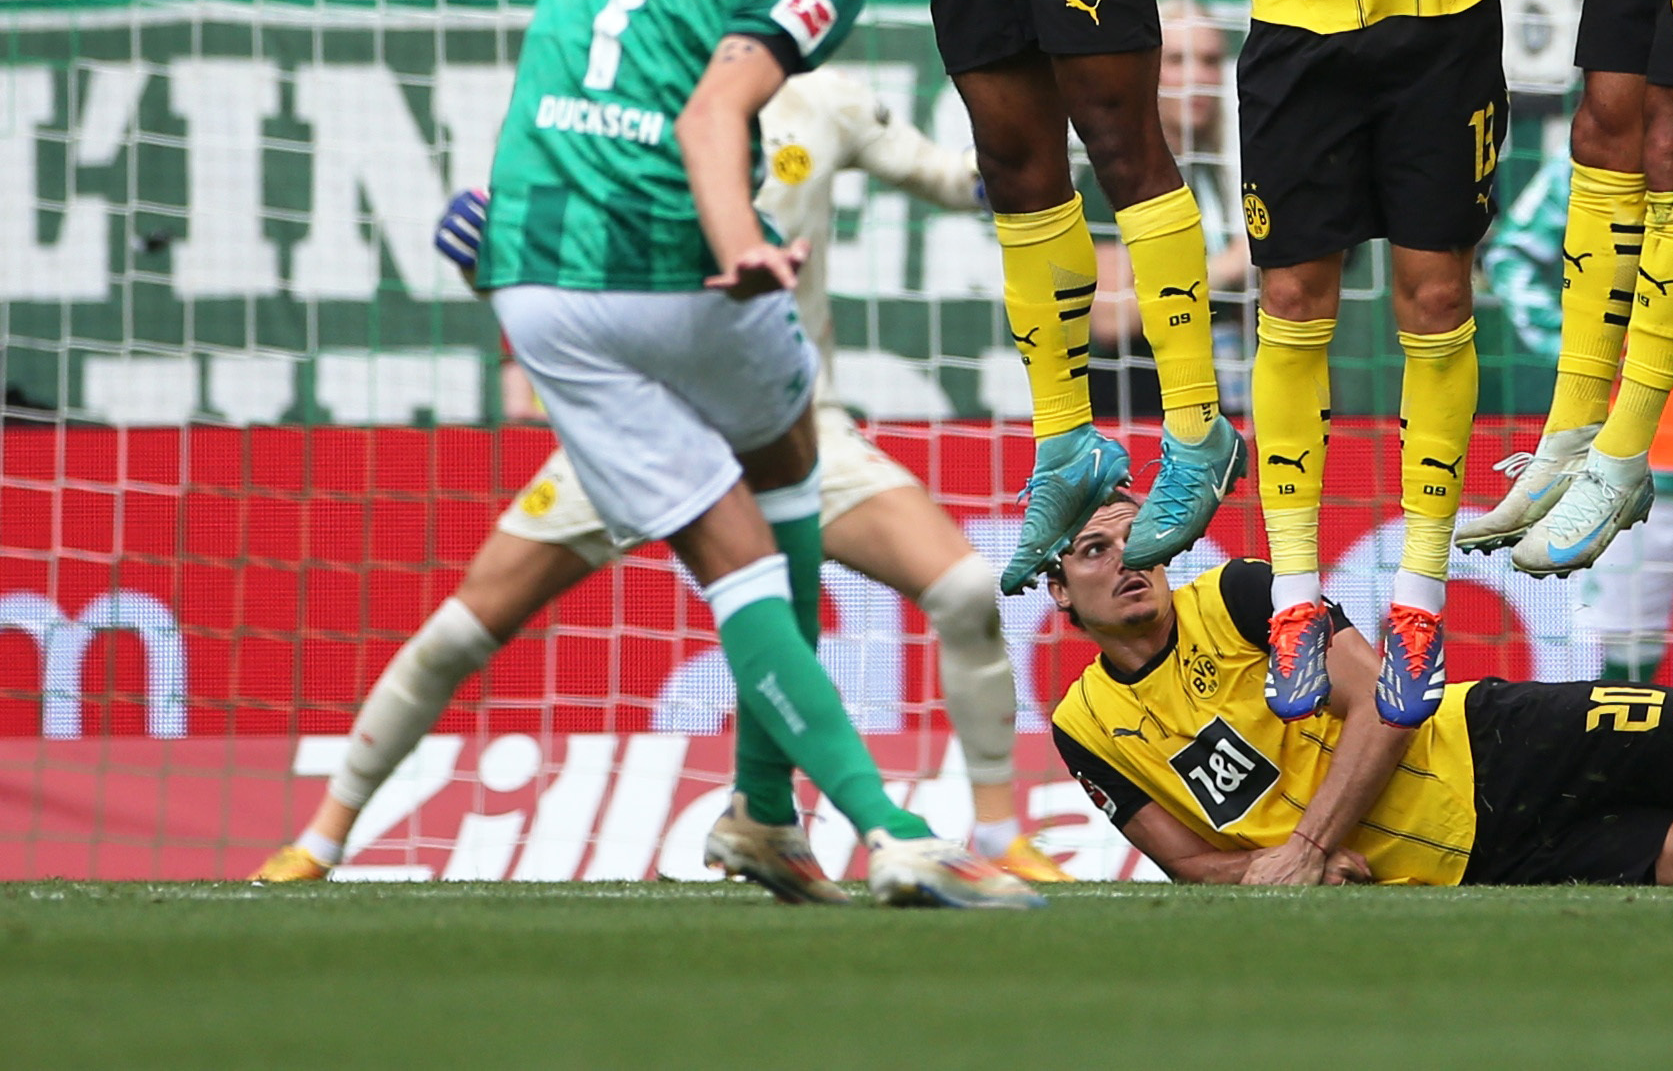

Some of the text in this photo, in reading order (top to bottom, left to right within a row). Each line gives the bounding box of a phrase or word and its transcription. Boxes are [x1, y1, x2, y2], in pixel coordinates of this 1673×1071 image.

[536, 94, 664, 146] DUCKSCH
[1468, 100, 1497, 183] 13
[1245, 199, 1267, 226] BVB
[1169, 312, 1191, 327] 09
[1277, 484, 1295, 495] 19
[1423, 485, 1447, 497] 09
[1192, 659, 1217, 694] BVB
[1585, 686, 1667, 733] 20
[1188, 737, 1256, 805] 1&1
